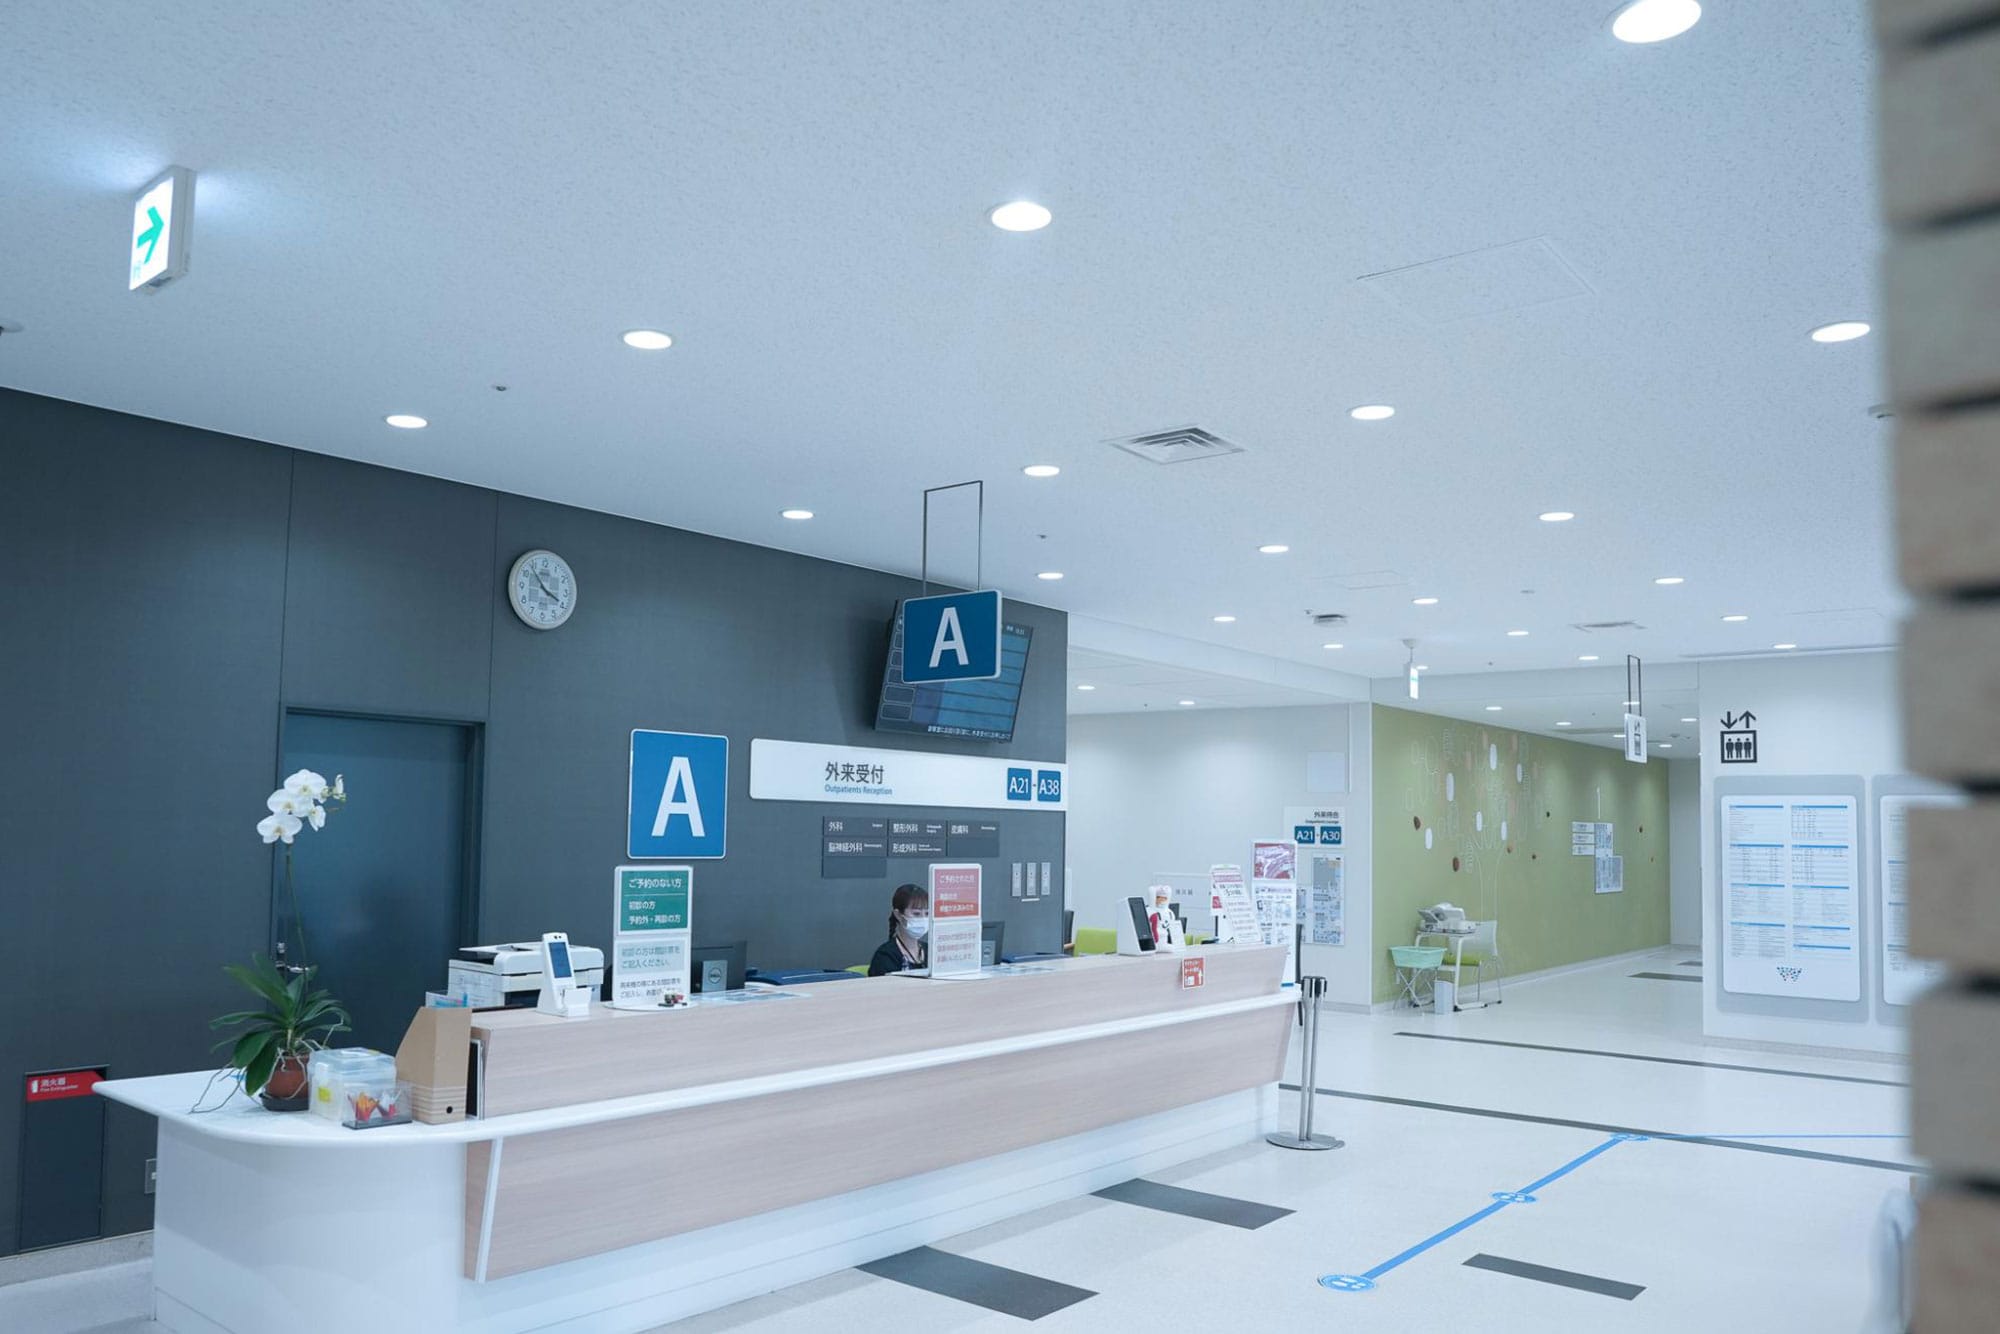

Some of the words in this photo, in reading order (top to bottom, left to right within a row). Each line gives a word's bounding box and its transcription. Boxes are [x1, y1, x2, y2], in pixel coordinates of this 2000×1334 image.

[929, 606, 969, 668] A
[825, 761, 884, 785] 外来受付
[824, 784, 862, 794] Outpatients
[863, 786, 893, 795] Reception
[1009, 776, 1029, 794] A21
[1039, 778, 1060, 796] A38
[651, 756, 705, 837] A
[828, 821, 843, 832] 外科
[1296, 830, 1313, 841] A21
[1321, 831, 1340, 841] A30
[628, 877, 682, 889] ご予約のない方
